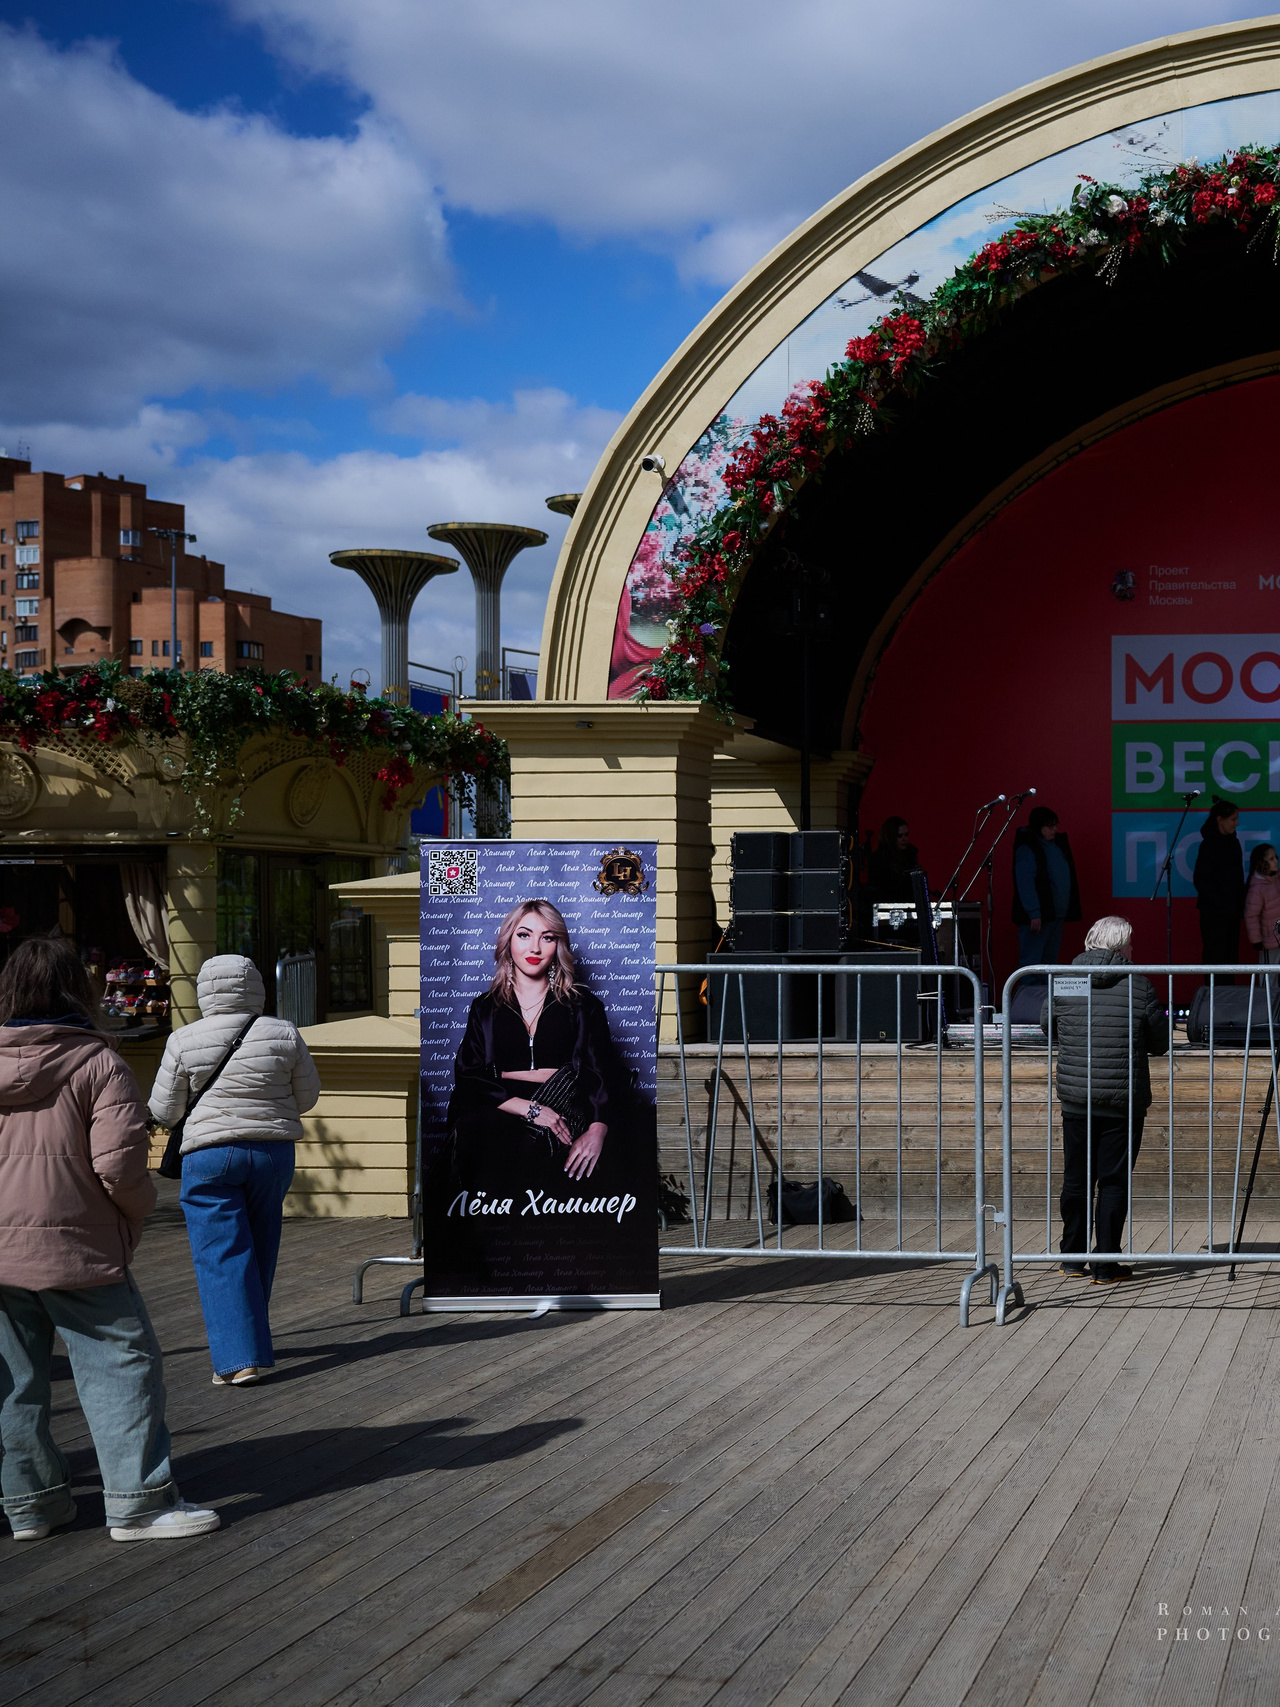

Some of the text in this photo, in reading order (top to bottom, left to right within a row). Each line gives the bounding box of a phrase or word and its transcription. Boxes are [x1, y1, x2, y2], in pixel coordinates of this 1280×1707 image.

[1149, 565, 1190, 577] Проект
[1149, 580, 1236, 592] Правительства
[1149, 595, 1193, 606] Москвы
[483, 848, 516, 858] Хаммер
[526, 848, 580, 858] Леля Хаммер
[496, 864, 514, 872] Леля
[517, 864, 549, 874] Хаммер
[561, 864, 579, 872] Леля
[483, 880, 516, 889] Хаммер
[548, 880, 580, 889] Хаммер
[428, 896, 483, 905] Леля Хаммер
[494, 895, 513, 903] Леля
[558, 895, 610, 905] Леля Хаммер
[420, 911, 453, 921] Хаммер
[464, 911, 482, 919] Леля
[612, 911, 643, 920] Хаммер
[428, 927, 483, 937] Леля Хаммер
[578, 926, 610, 936] Хаммер
[620, 926, 638, 934] Леля
[608, 942, 640, 951] Хаммер
[452, 958, 484, 968] Хаммер
[580, 957, 612, 967] Хаммер
[621, 957, 640, 965] Леля
[461, 974, 479, 982] Леля
[608, 973, 640, 982] Хаммер
[428, 990, 447, 998] Леля
[619, 988, 637, 996] Леля
[420, 1006, 453, 1015] Хаммер
[611, 1004, 642, 1013] Хаммер
[428, 1021, 448, 1029] Леля
[430, 1052, 450, 1060] Леля
[447, 1189, 637, 1224] Лёля Хаммер
